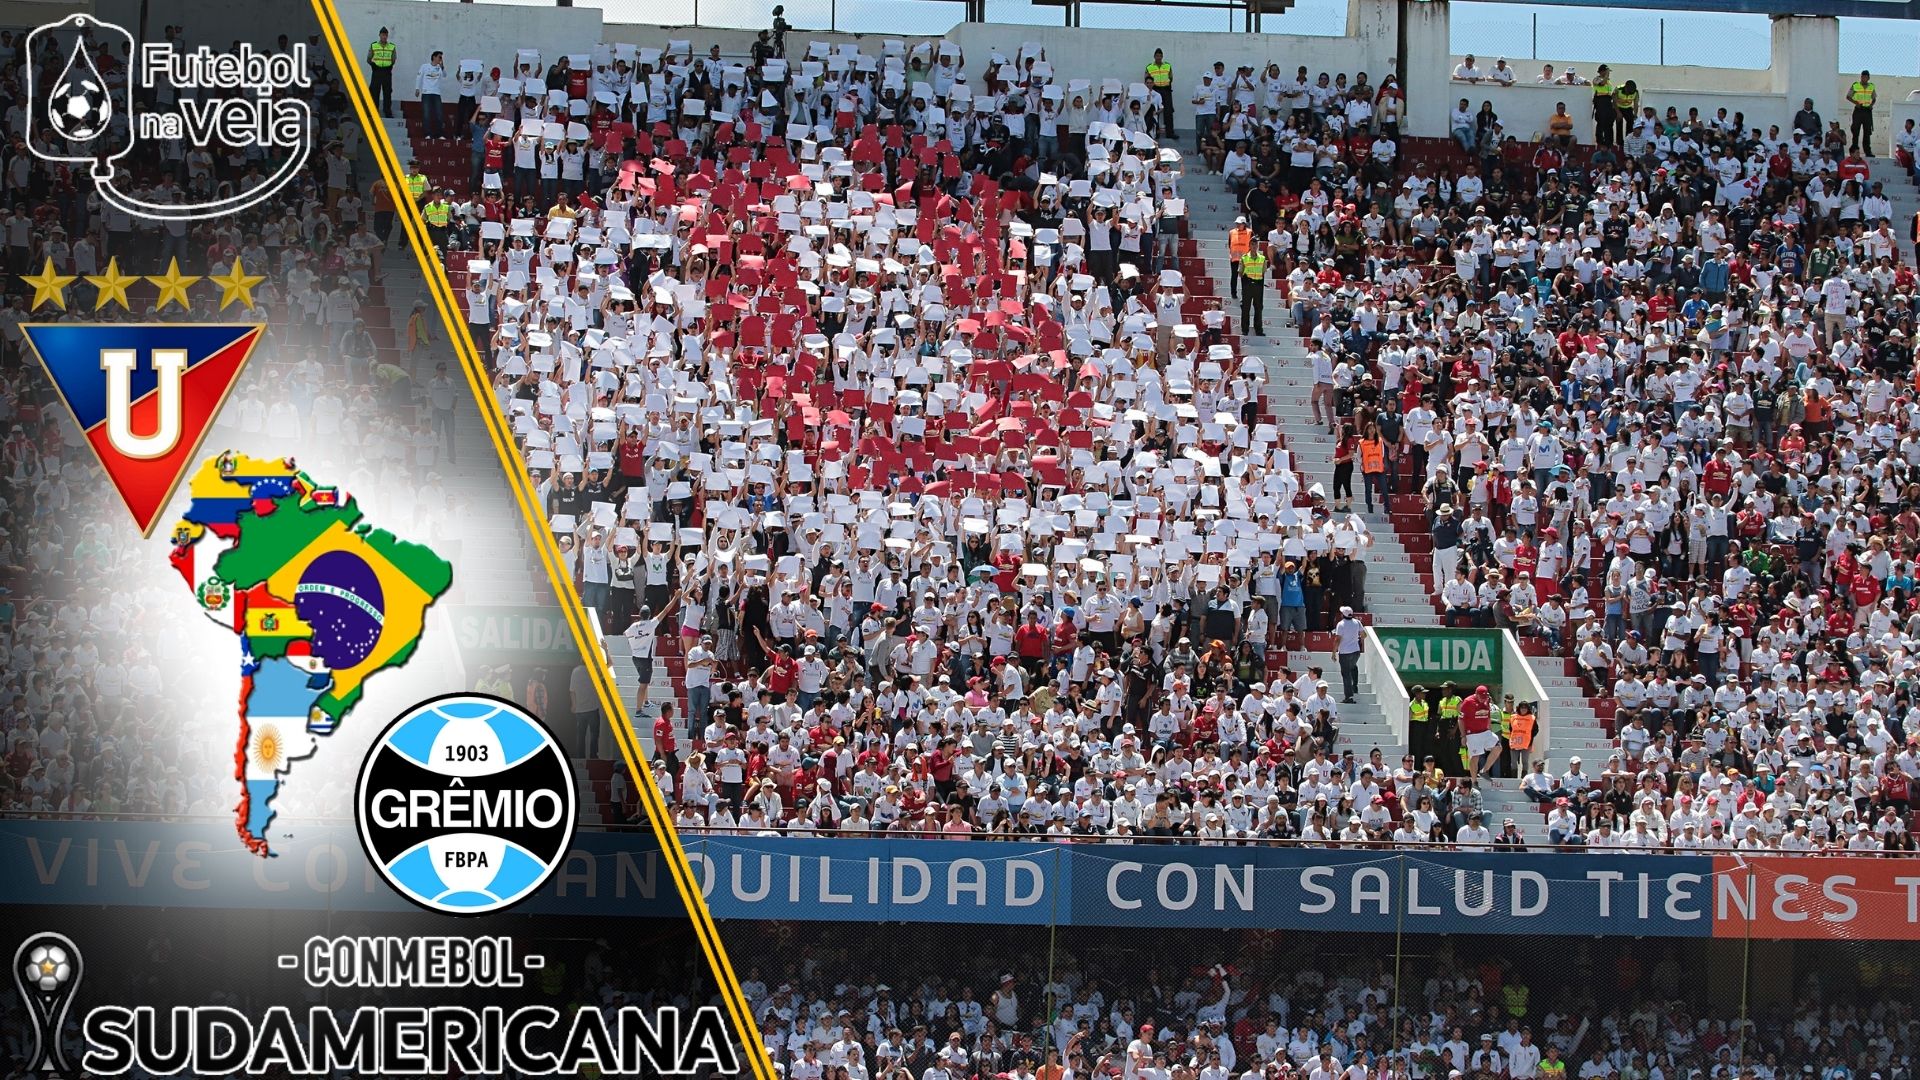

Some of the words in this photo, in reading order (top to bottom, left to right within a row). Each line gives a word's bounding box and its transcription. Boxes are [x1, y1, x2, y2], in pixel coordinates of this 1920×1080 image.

[460, 615, 574, 650] SALIDA
[1383, 638, 1493, 672] SALIDA
[1537, 659, 1550, 667] FILA
[1551, 679, 1564, 687] FILA
[1561, 700, 1575, 708] FILA
[1572, 720, 1586, 728] FILA
[27, 837, 212, 891] VIVE
[252, 840, 376, 894] CO
[1106, 861, 1254, 912] CON
[1299, 866, 1549, 917] SALUD
[1586, 869, 1859, 923] TIENES
